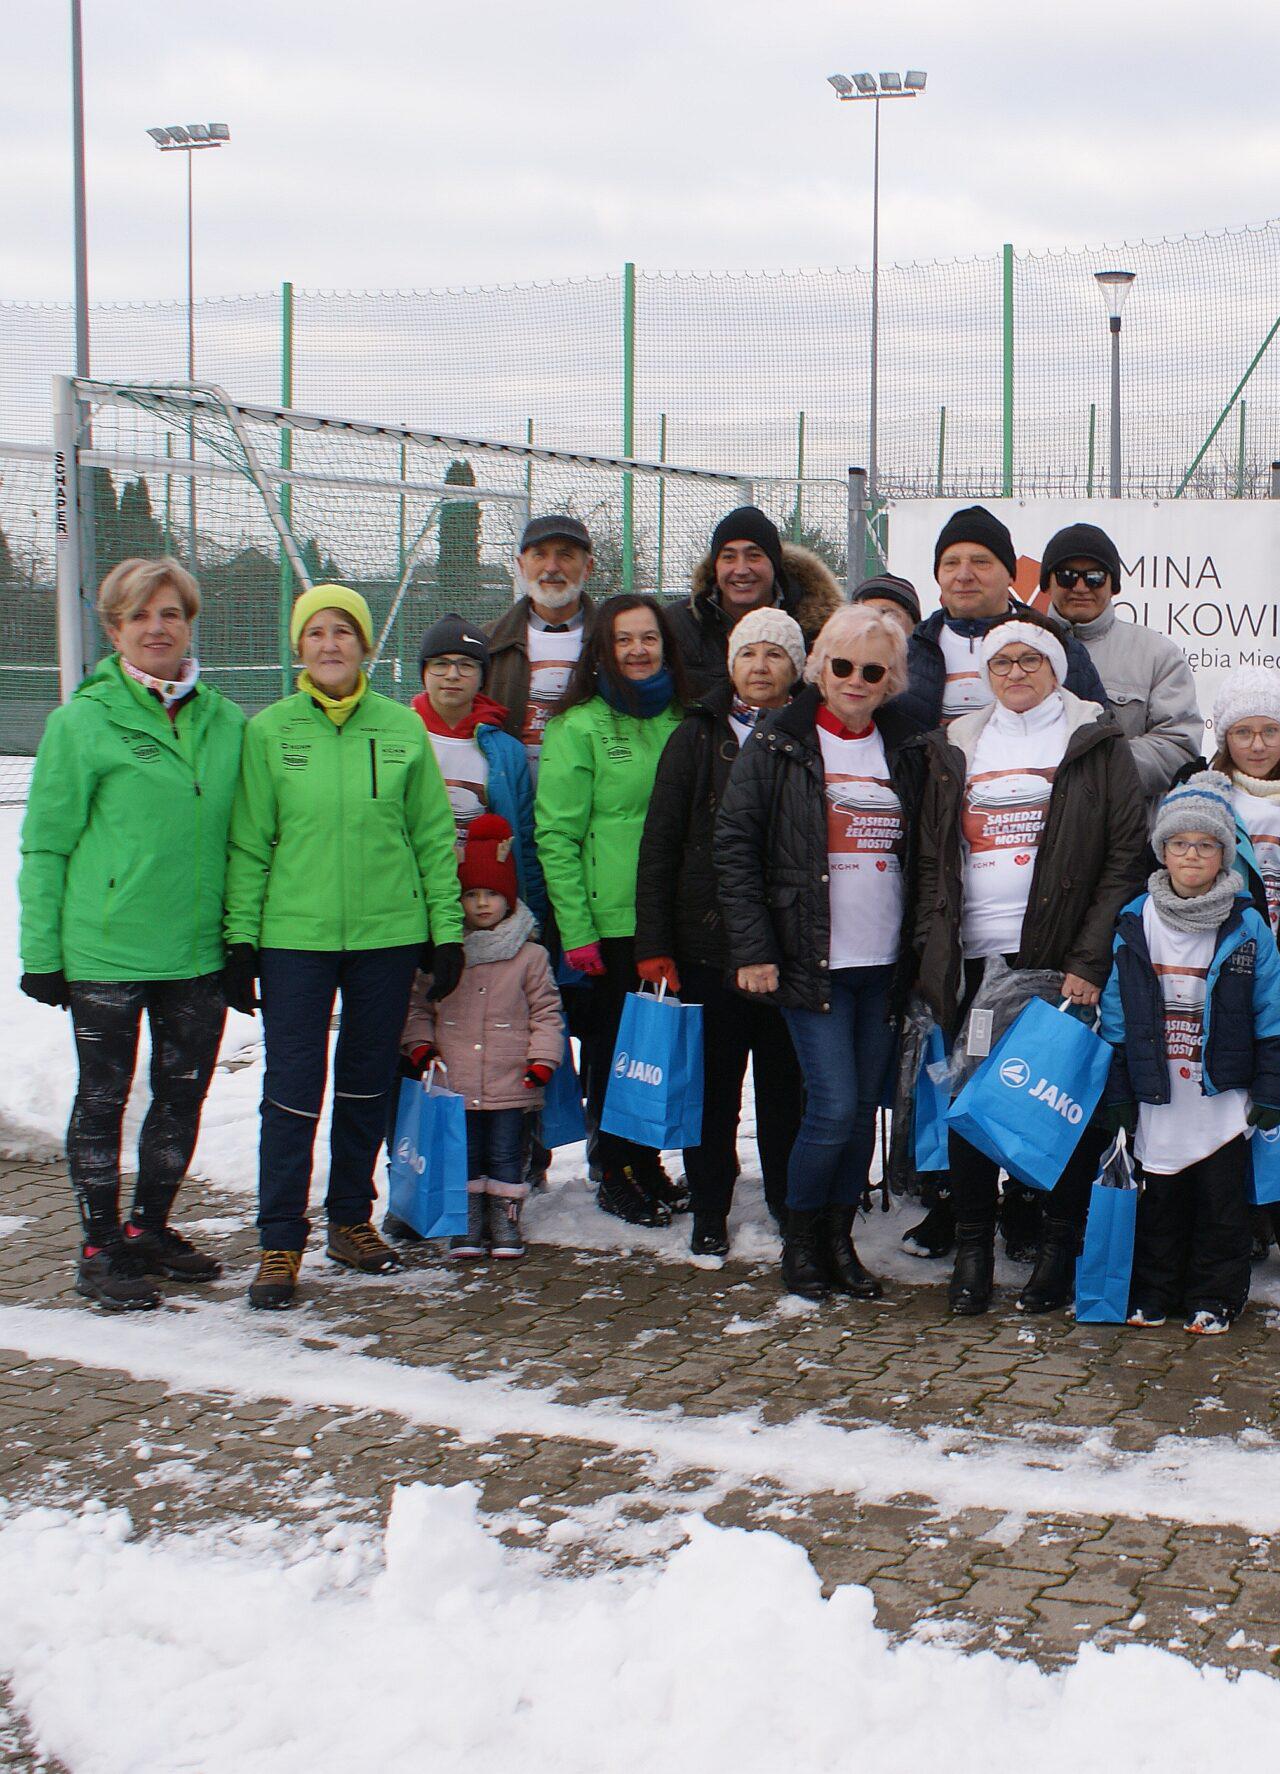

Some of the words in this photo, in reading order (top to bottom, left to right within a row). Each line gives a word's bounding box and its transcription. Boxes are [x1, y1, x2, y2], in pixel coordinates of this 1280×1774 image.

[1119, 556, 1222, 589] MINA
[987, 811, 1043, 826] SĄSIEDZI
[857, 839, 893, 850] MOSTU
[995, 833, 1037, 846] MOSTU
[626, 1060, 663, 1086] JAKO
[1028, 1078, 1083, 1125] JAKO
